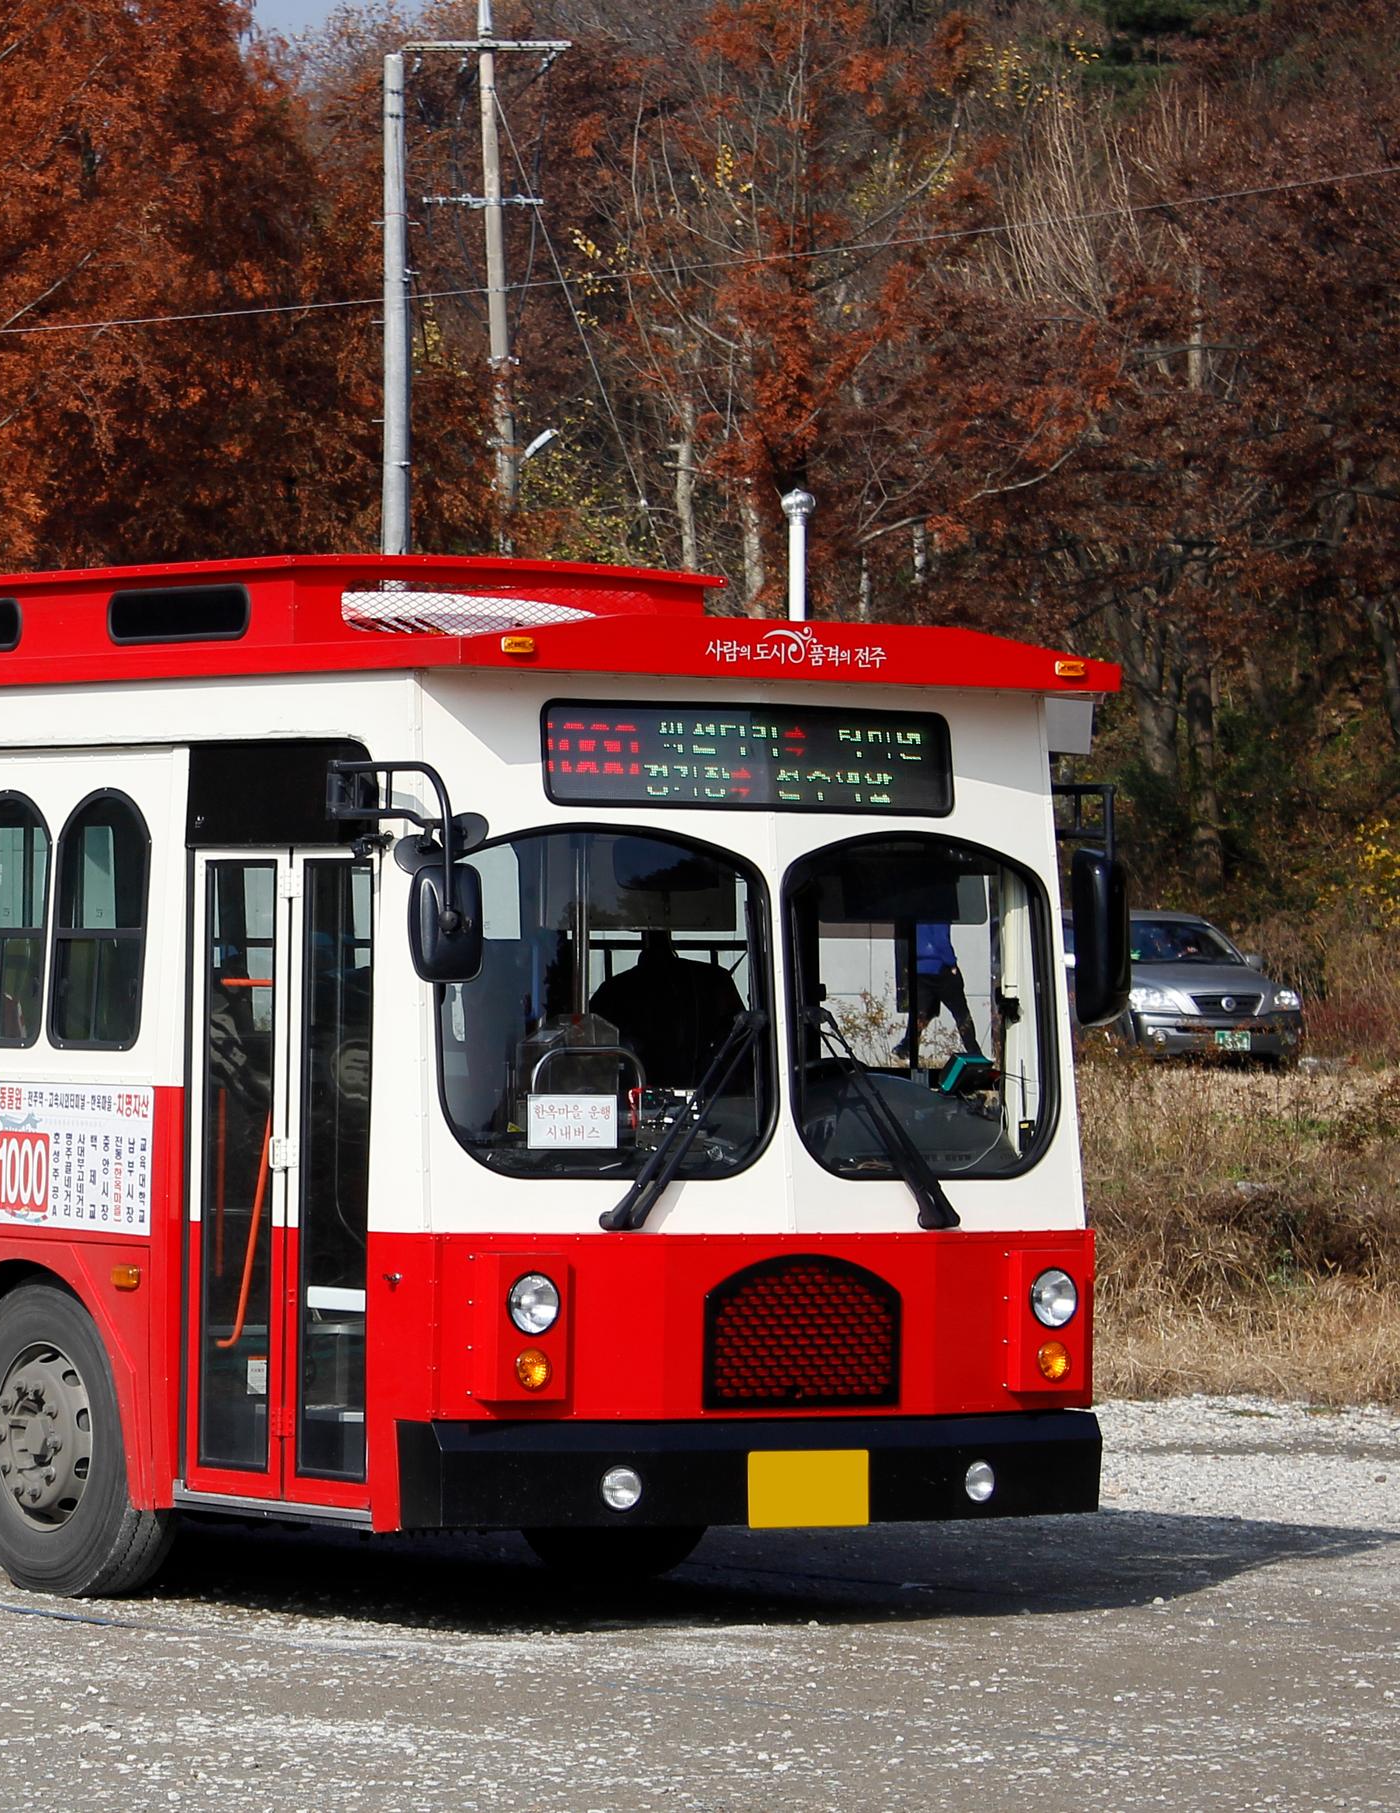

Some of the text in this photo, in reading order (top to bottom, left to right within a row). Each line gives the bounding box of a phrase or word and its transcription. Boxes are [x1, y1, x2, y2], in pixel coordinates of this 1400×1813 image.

[705, 639, 887, 668] 사람의 도시 품격의 전주
[0, 1087, 22, 1110] 동물원
[27, 1090, 44, 1108] 전주역
[91, 1094, 112, 1112] 한옥마을
[116, 1093, 149, 1118] 치명자산
[534, 1103, 611, 1120] 한옥마을 운행
[546, 1125, 601, 1141] 시내버스
